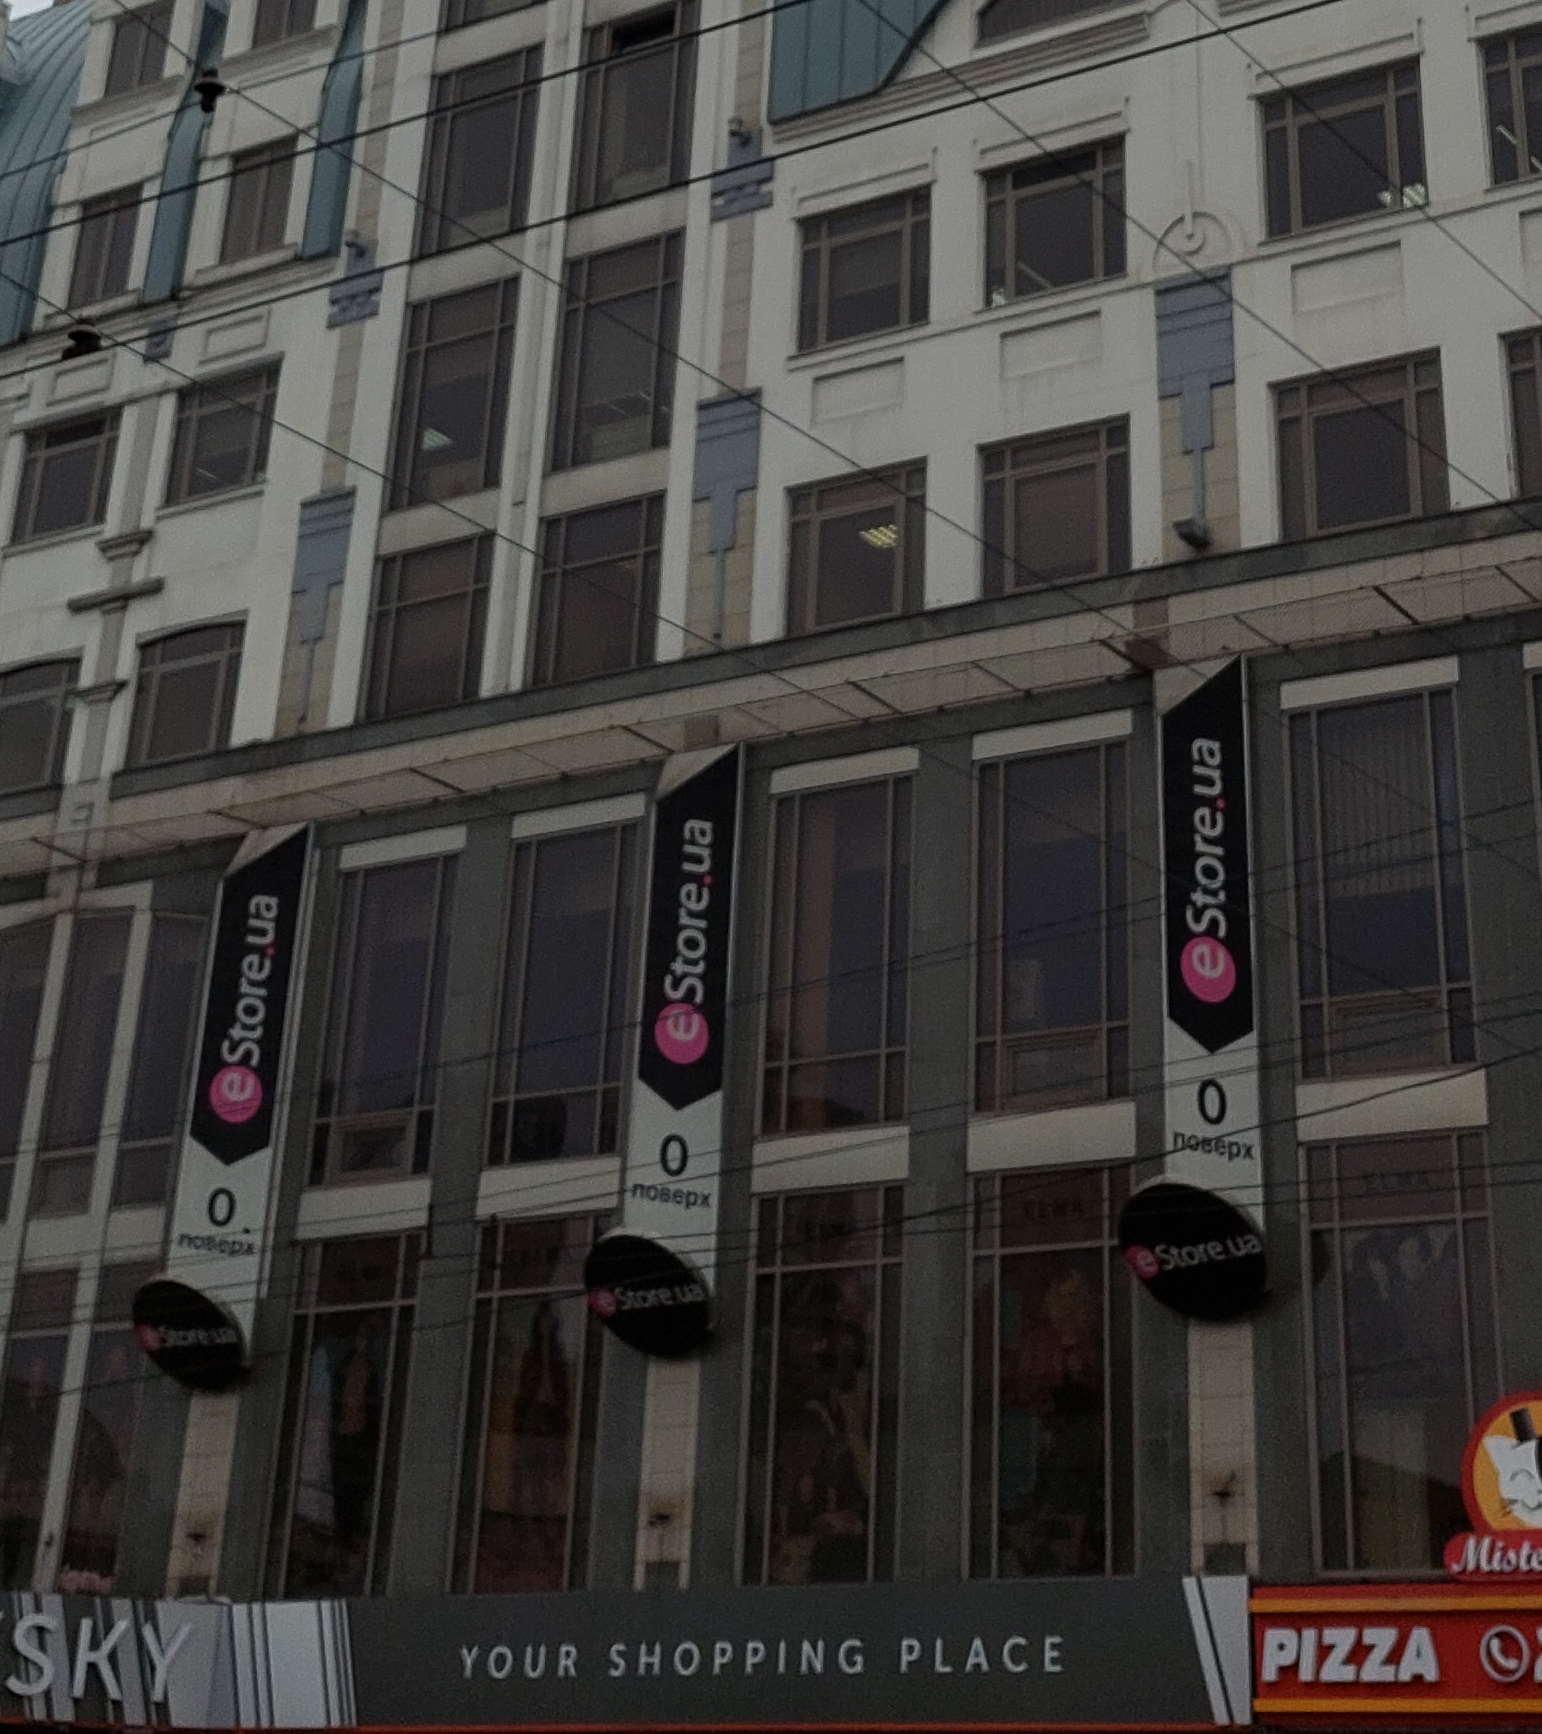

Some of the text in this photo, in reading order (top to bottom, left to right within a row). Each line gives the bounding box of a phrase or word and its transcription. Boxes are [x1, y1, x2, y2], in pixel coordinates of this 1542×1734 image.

[1186, 736, 1228, 980] eStore.ua
[664, 817, 714, 1042] eStore.ua
[220, 893, 280, 1103] eStore.ua
[1172, 1131, 1255, 1162] поверх
[631, 1183, 712, 1209] поверх
[459, 1634, 1066, 1679] YOUR SHOPPING PLACE
[1260, 1626, 1441, 1684] PIZZA
